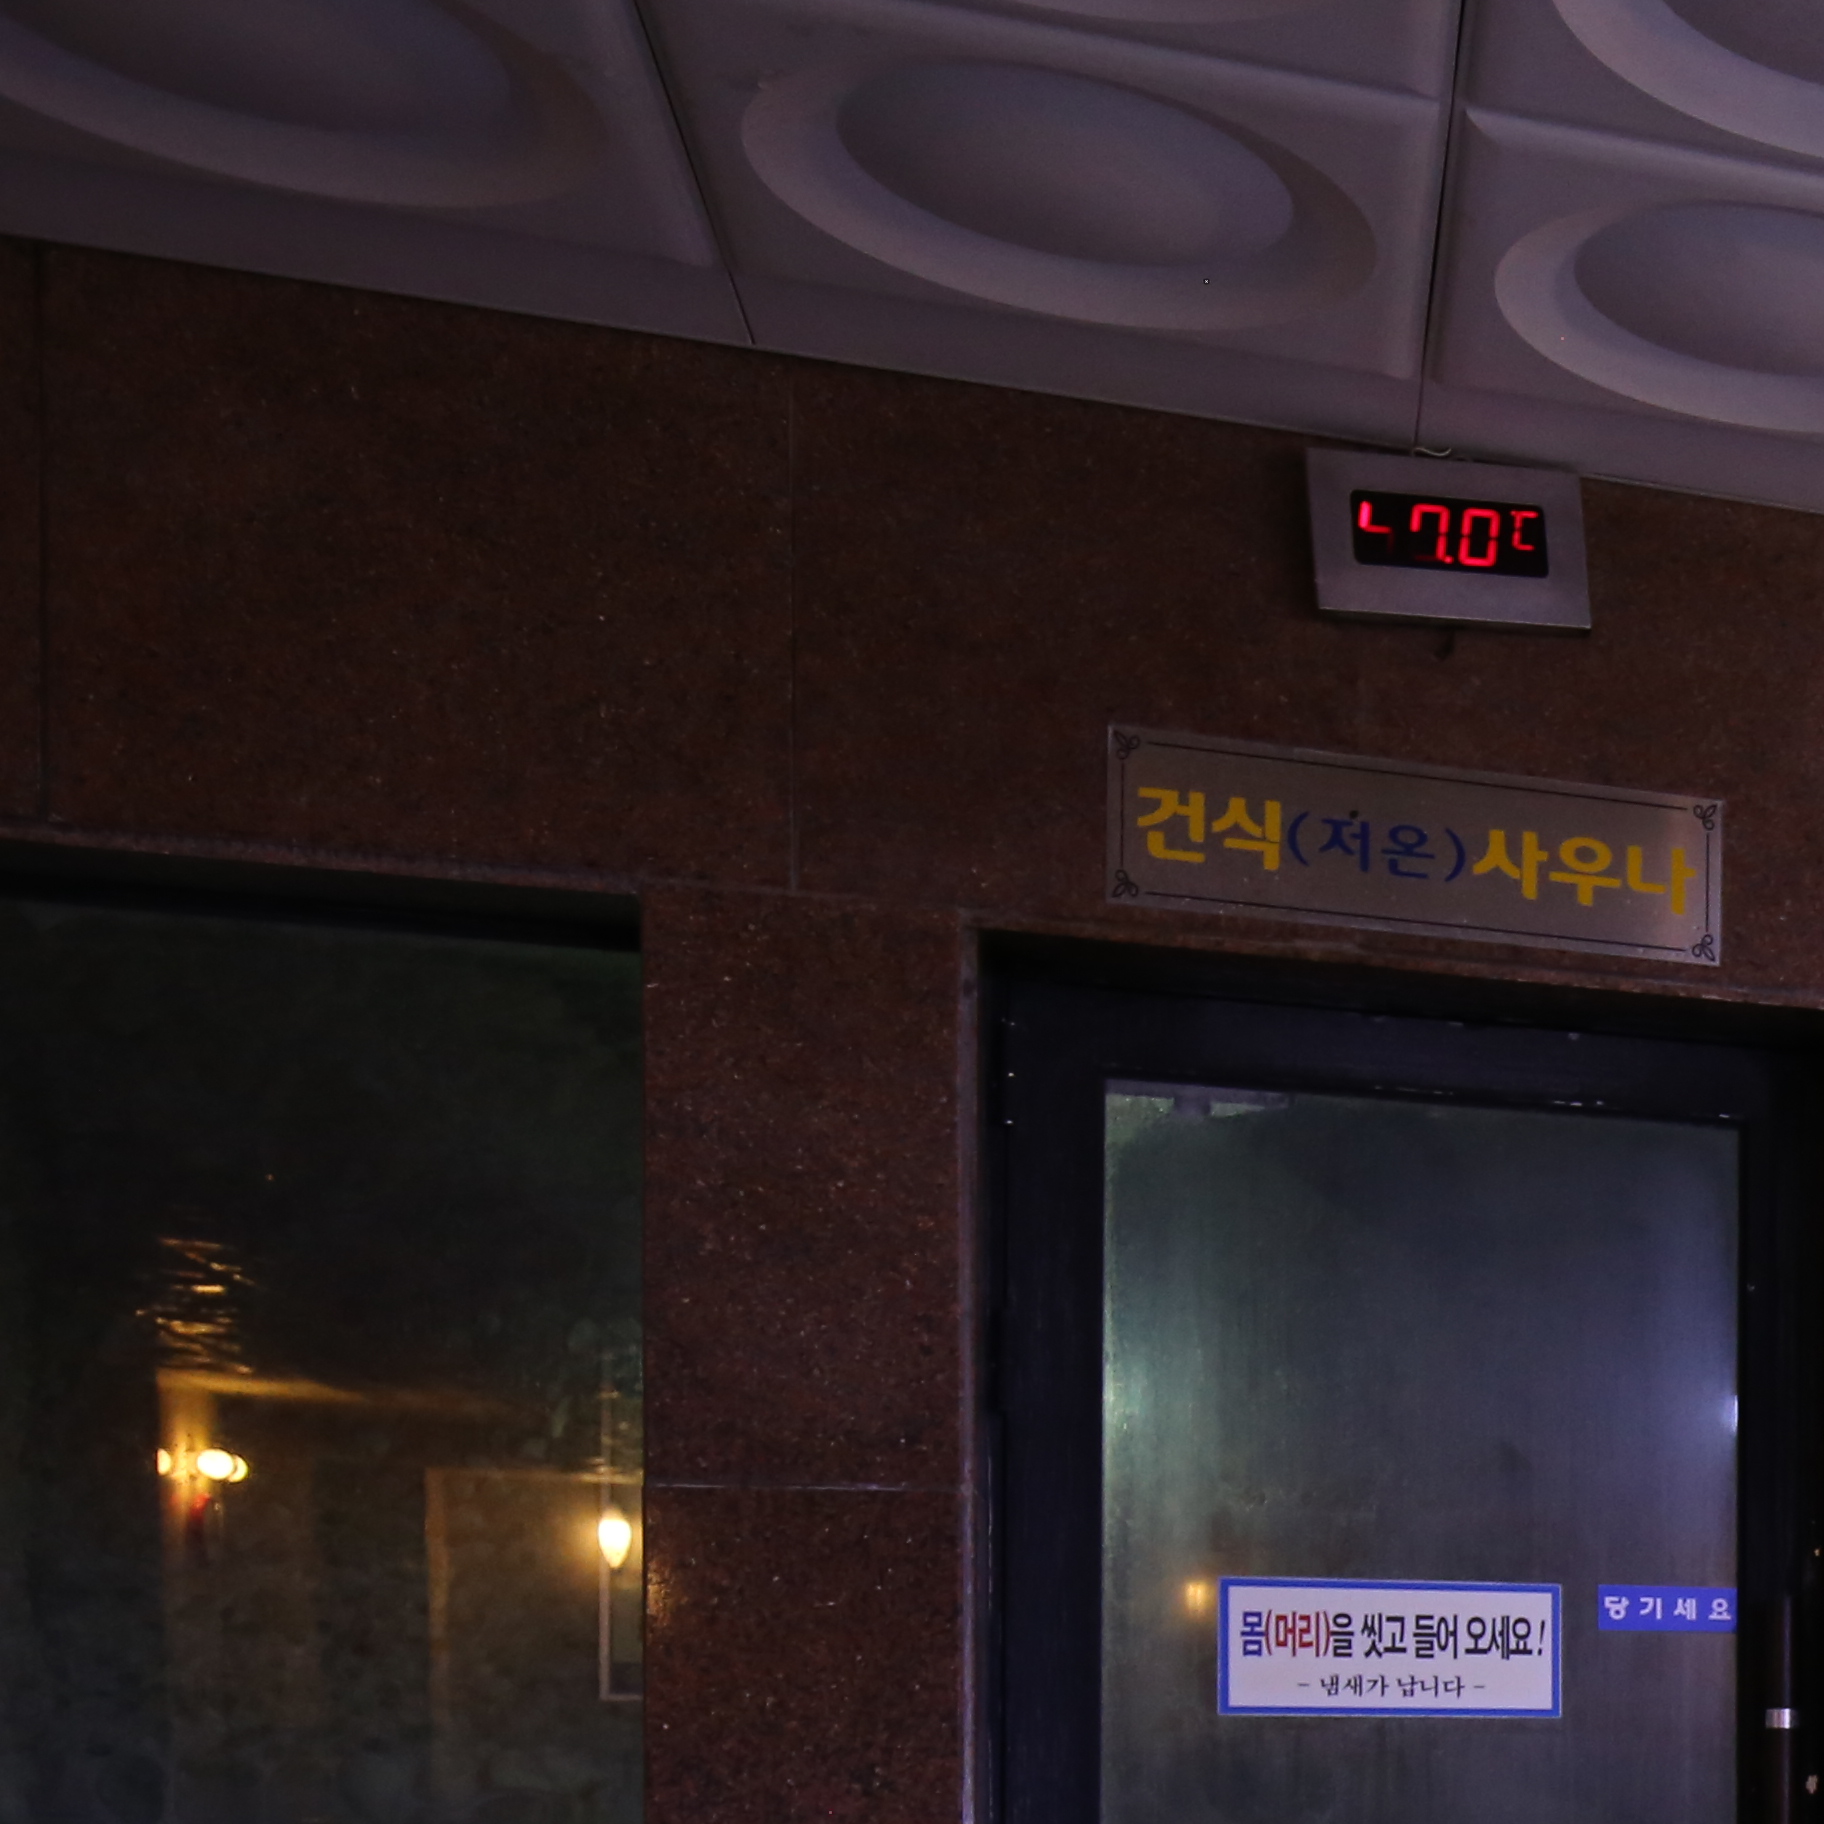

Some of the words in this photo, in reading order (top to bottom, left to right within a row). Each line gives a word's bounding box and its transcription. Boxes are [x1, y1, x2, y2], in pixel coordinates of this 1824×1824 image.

[1136, 786, 1696, 915] 건식(저온)사우나
[1604, 1595, 1732, 1621] 당기세요
[1240, 1609, 1354, 1658] 몸(머리)을
[1361, 1611, 1407, 1659] 씻고
[1413, 1614, 1458, 1660] 들어
[1464, 1615, 1545, 1660] 오세요!
[1320, 1674, 1389, 1698] 냄새가
[1397, 1675, 1465, 1698] 납니다
